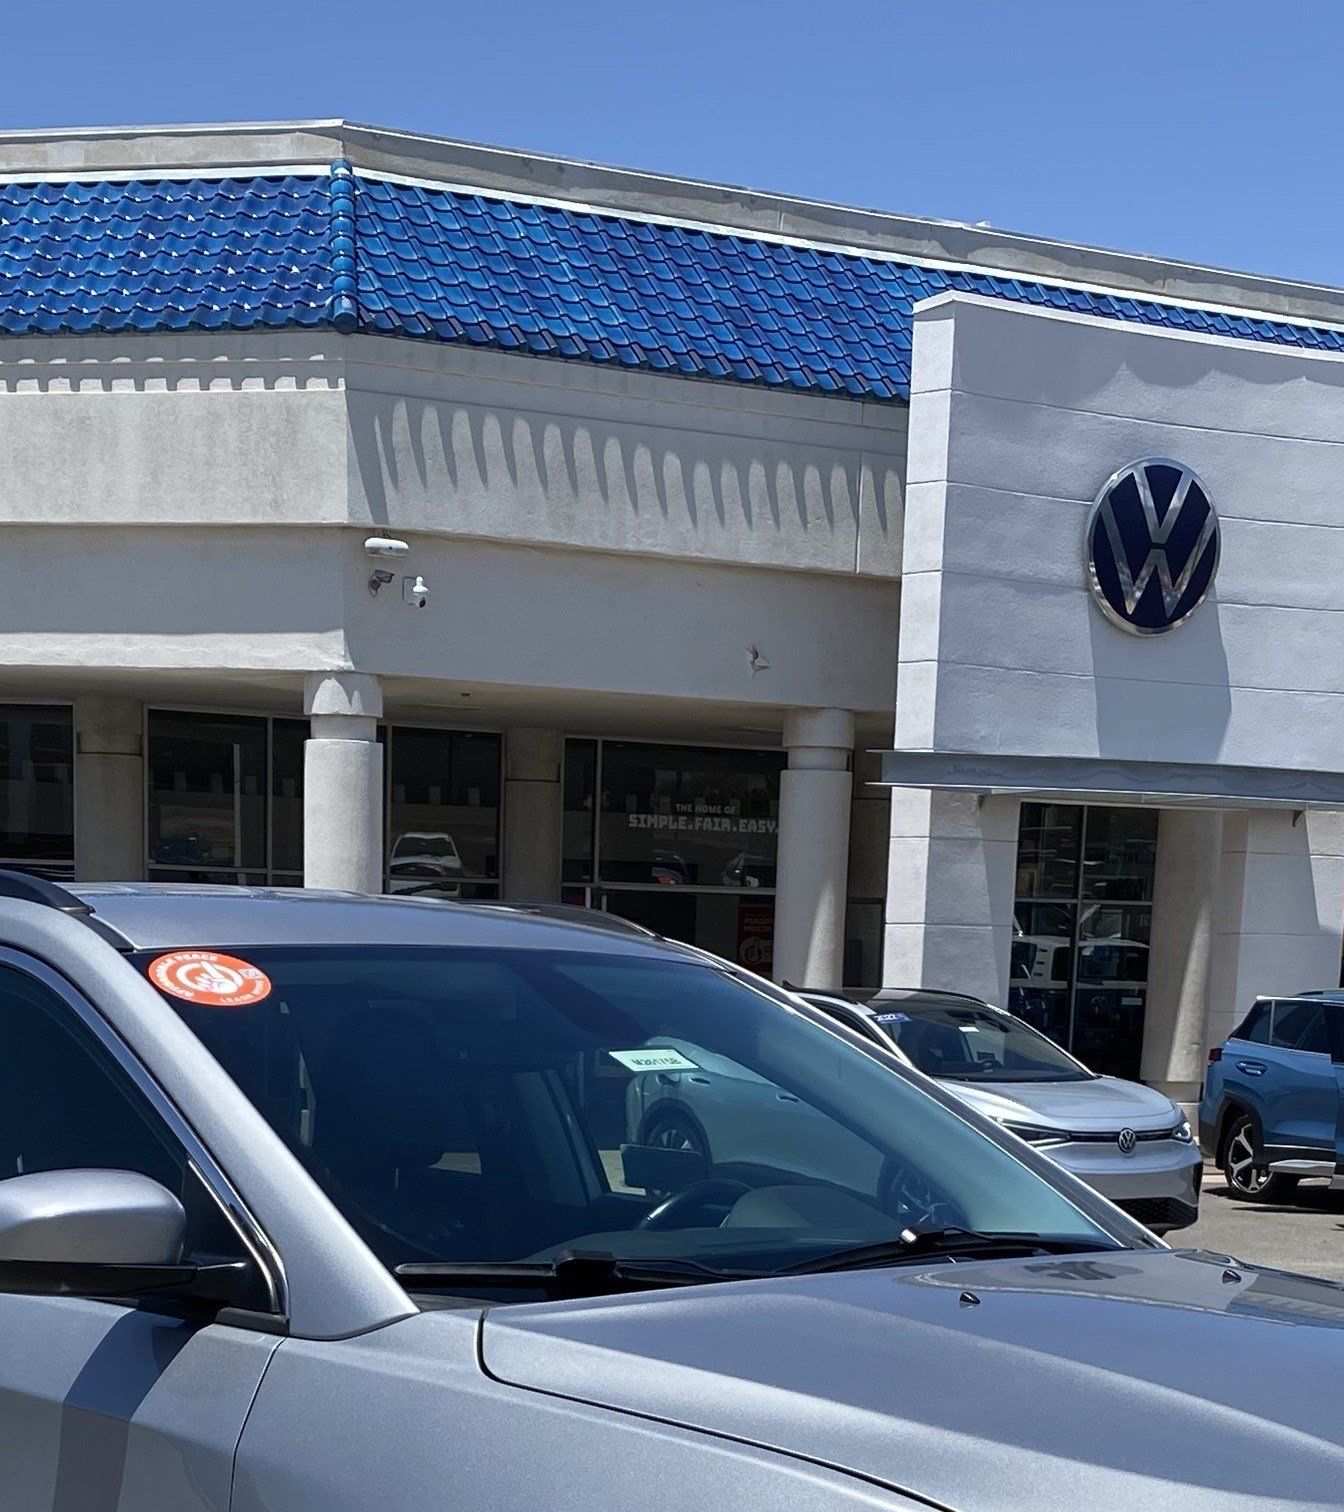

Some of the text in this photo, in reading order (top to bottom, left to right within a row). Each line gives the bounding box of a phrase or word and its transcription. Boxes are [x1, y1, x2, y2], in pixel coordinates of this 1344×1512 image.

[1091, 460, 1219, 630] VW
[676, 803, 737, 815] THE HOME OF
